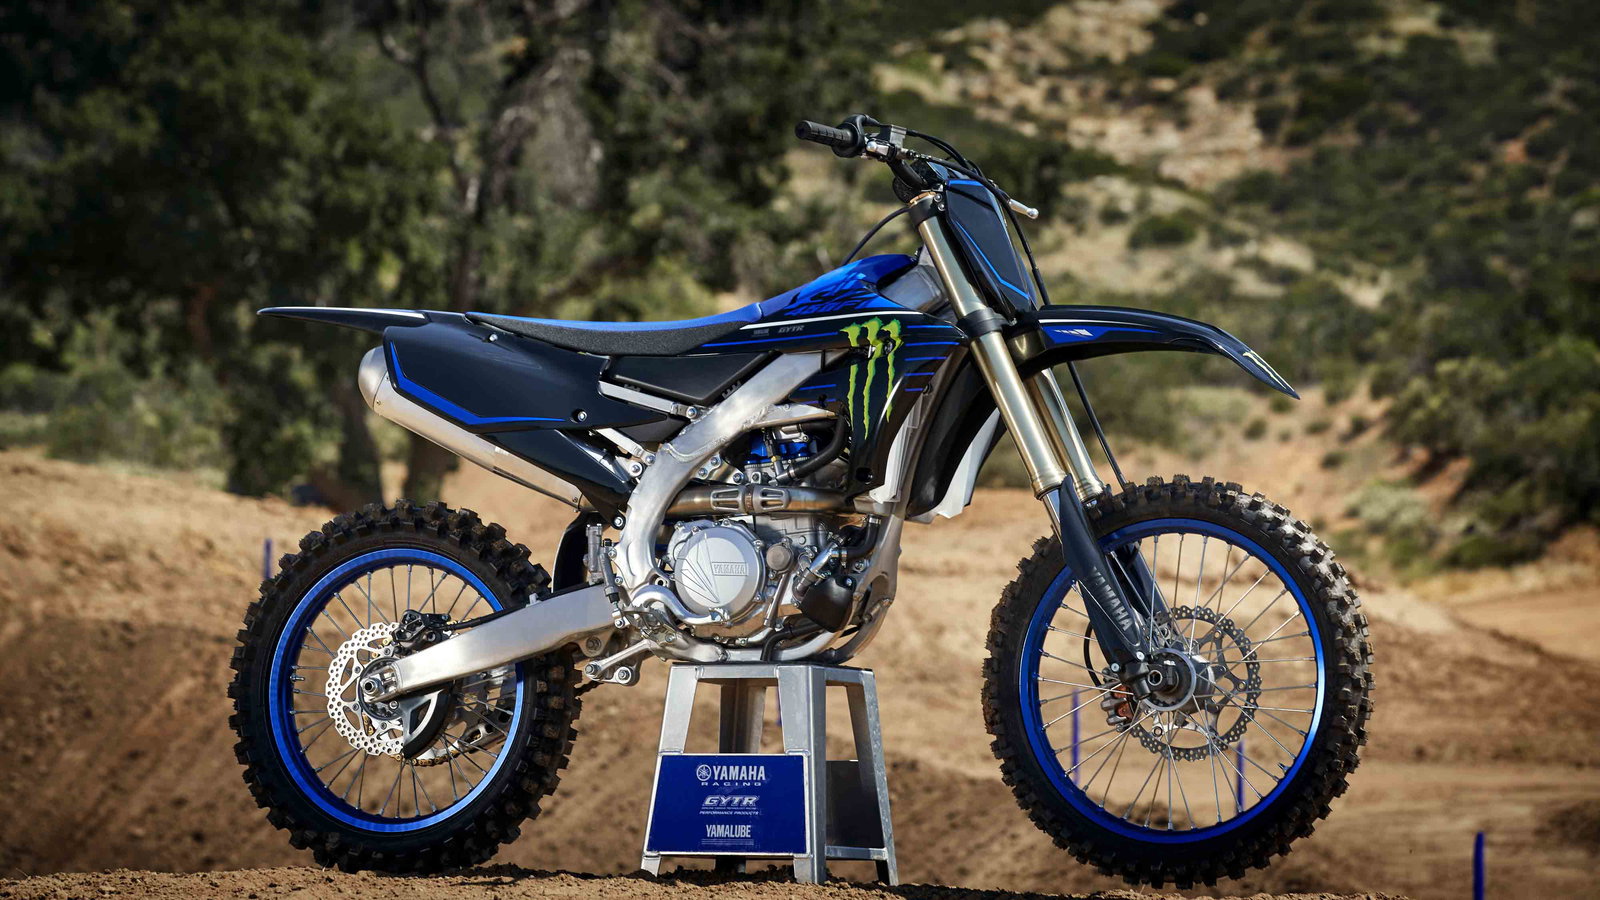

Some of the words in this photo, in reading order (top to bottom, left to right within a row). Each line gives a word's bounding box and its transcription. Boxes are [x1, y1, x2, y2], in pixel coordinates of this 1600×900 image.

[713, 564, 745, 574] YAMAHA
[1088, 565, 1134, 632] YAMAHA
[712, 765, 766, 780] YAMAHA
[702, 795, 760, 807] GYTR
[706, 824, 751, 838] YAMALUBE
